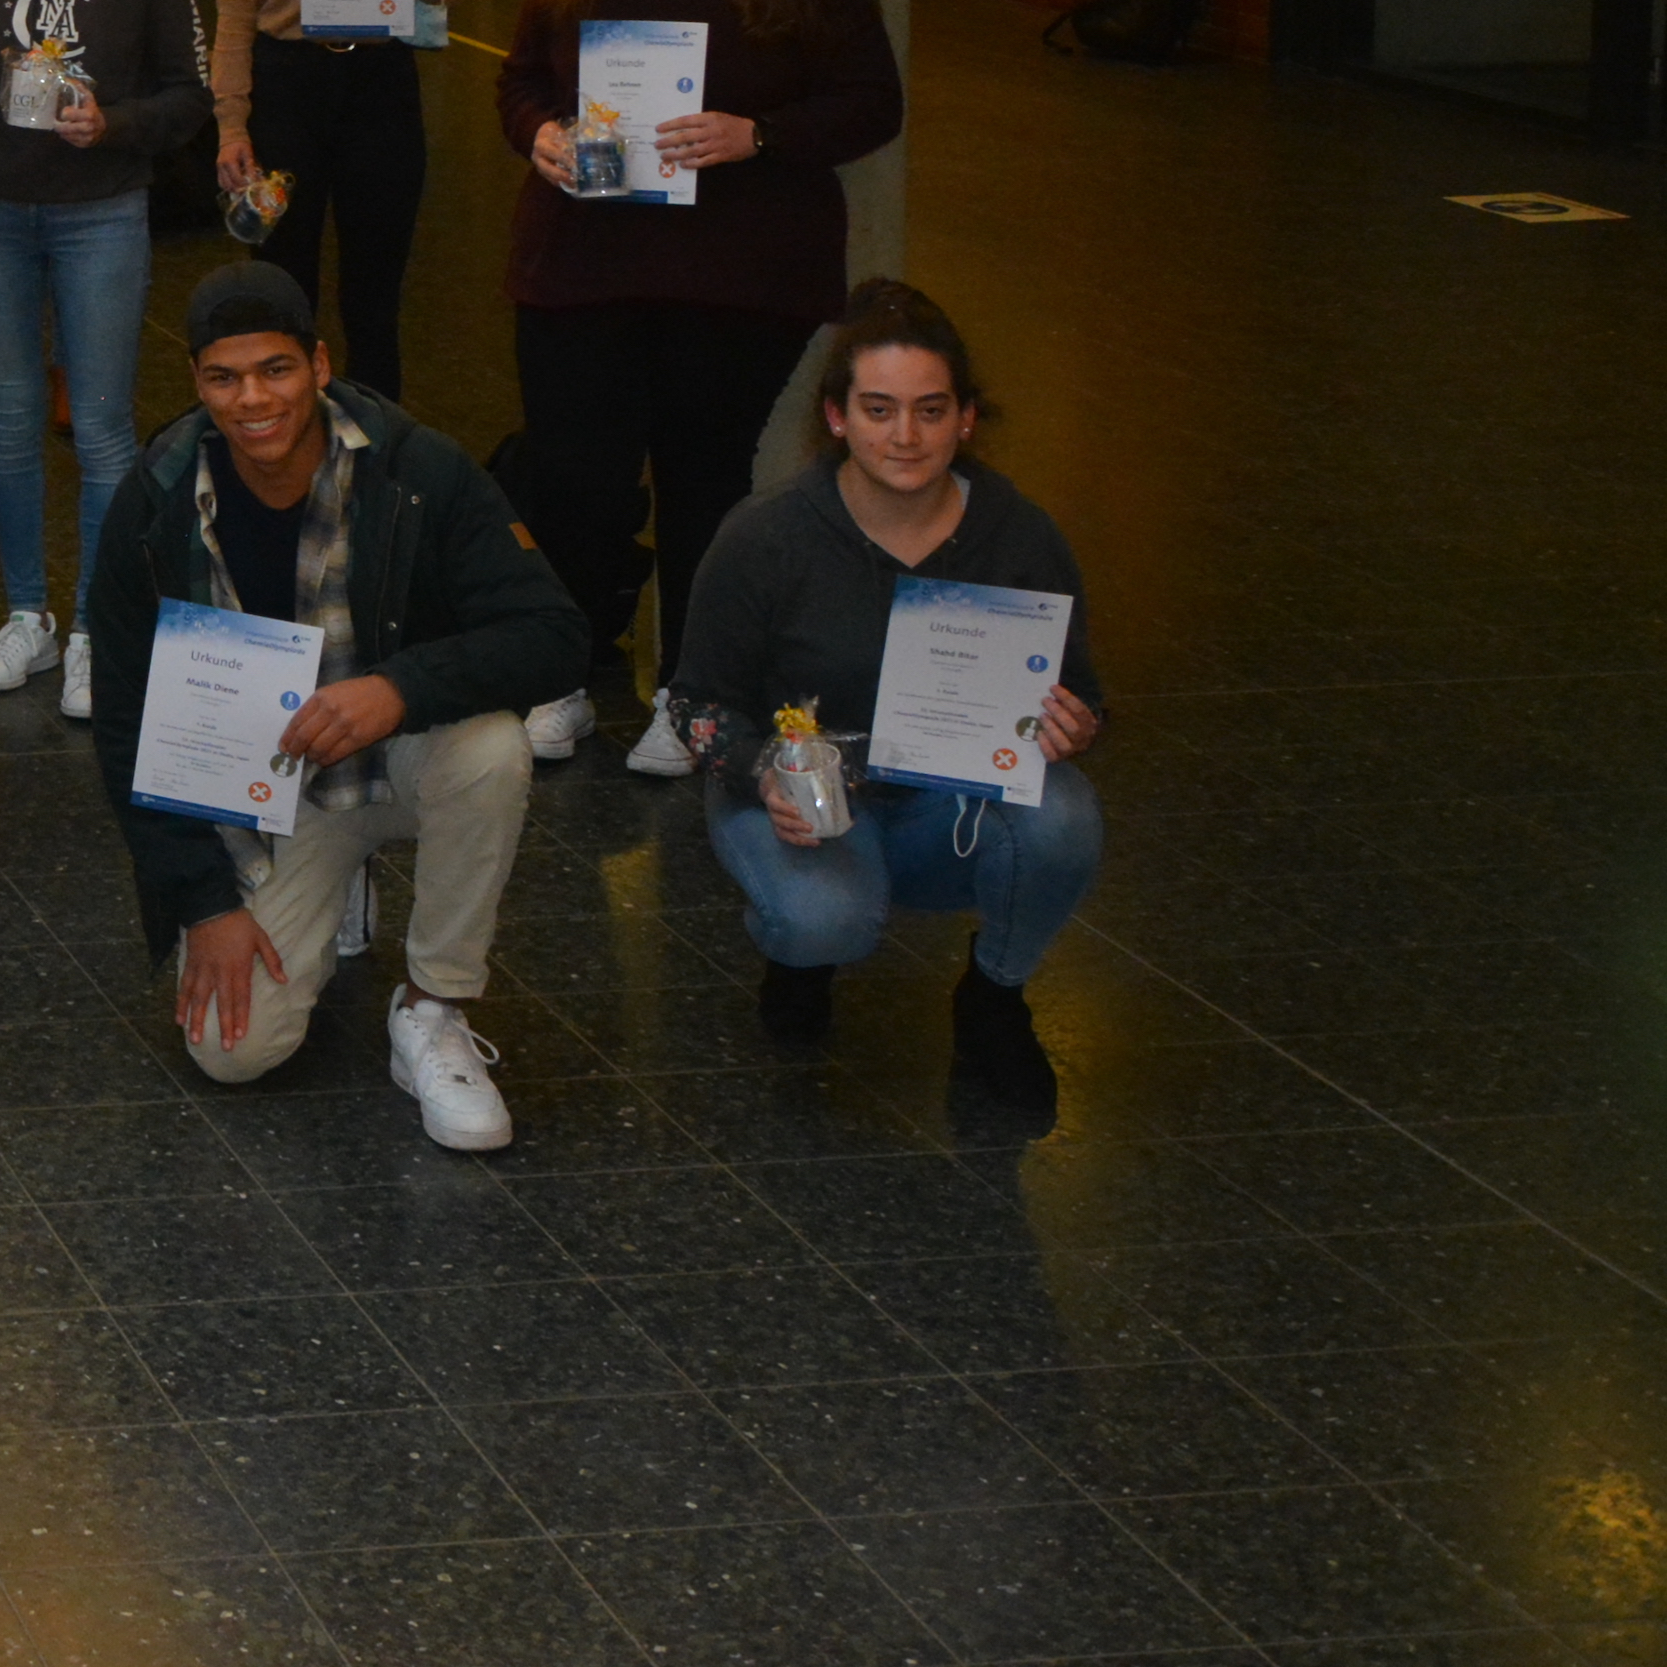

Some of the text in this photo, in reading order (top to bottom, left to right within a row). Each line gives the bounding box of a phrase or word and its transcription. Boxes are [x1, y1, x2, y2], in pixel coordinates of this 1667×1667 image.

[930, 622, 987, 639] Urkunde
[191, 651, 244, 671] Urkunde
[186, 677, 211, 690] Malik
